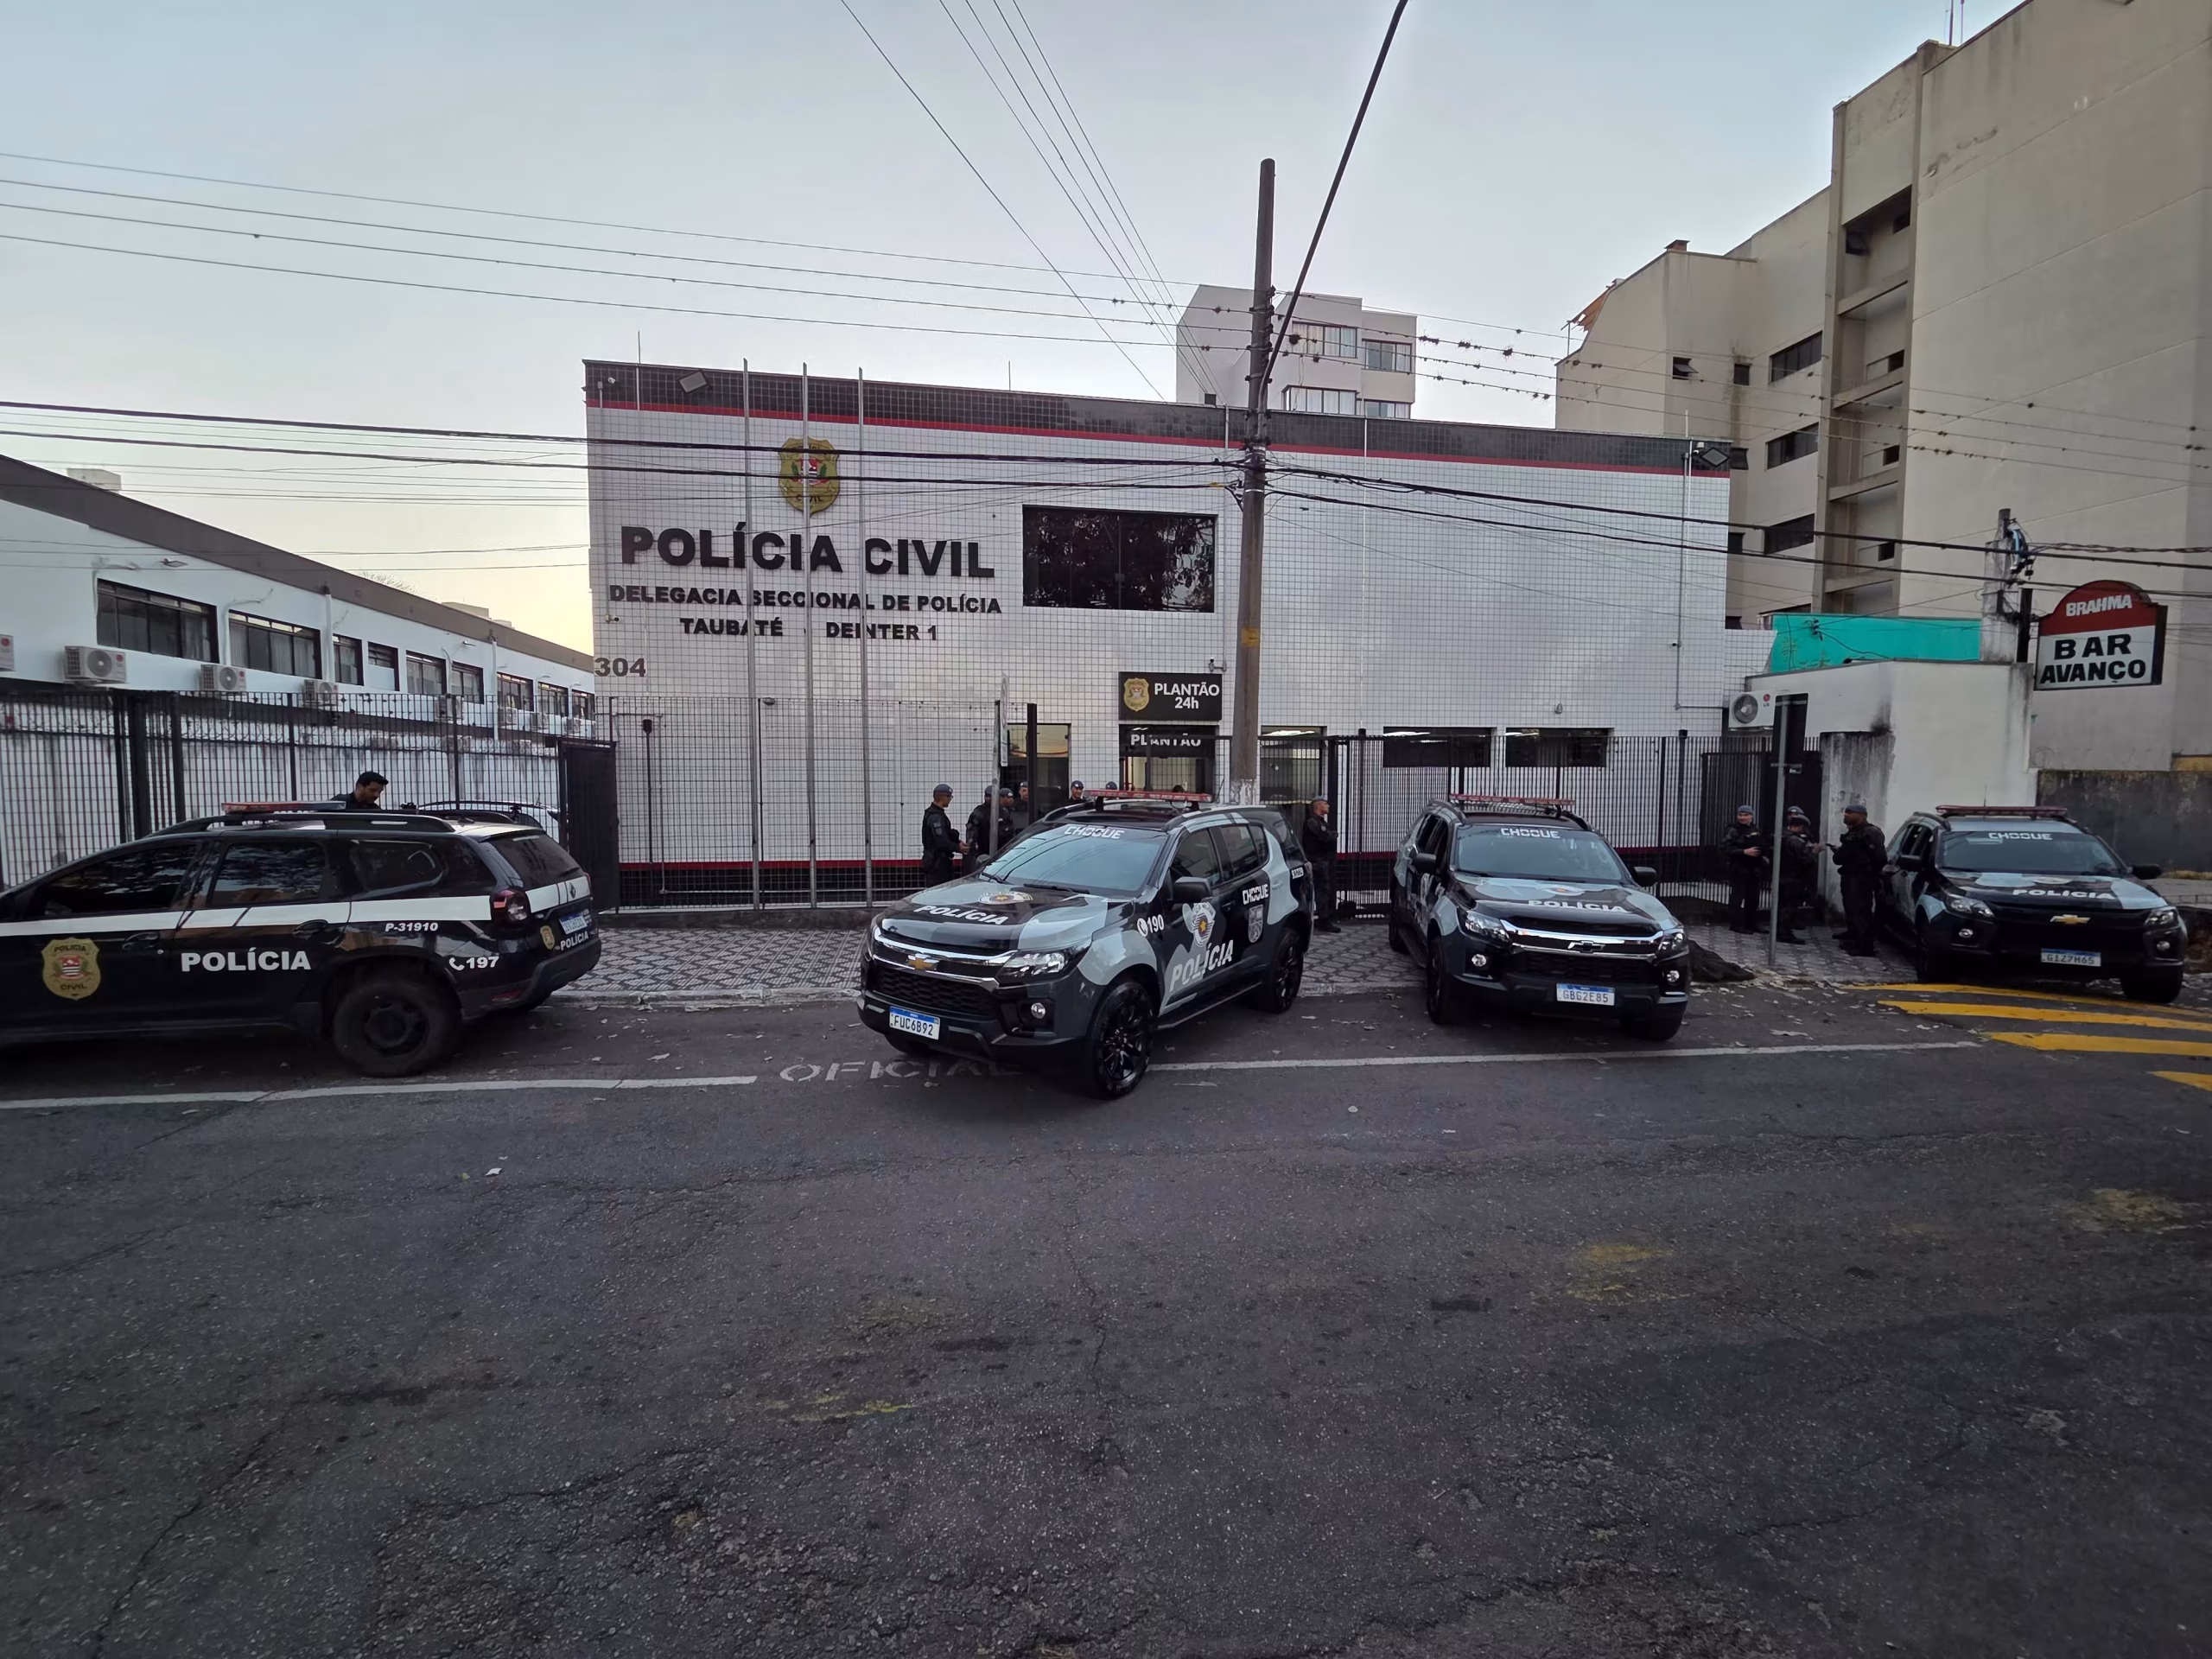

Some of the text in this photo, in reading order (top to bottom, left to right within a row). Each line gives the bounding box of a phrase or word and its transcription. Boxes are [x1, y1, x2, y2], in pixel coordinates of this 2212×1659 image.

[621, 521, 995, 578] POLÍCIA CIVIL
[609, 584, 1002, 614] DELEGACIA SECCIONAL DE POLÍCIA
[2065, 594, 2133, 617] BRAHMA
[679, 616, 937, 641] TAUBATÉ DEINTER 1
[2054, 633, 2132, 660] BAR
[594, 657, 646, 677] 304
[2039, 659, 2146, 683] AVANÇO
[1154, 681, 1220, 697] PLANTÃO
[1174, 696, 1199, 709] 24h
[913, 905, 1009, 925] POLÍCIA
[1147, 914, 1165, 934] 190
[385, 922, 439, 932] P-31910
[560, 930, 589, 951] POLÍCIA
[181, 947, 312, 972] POLÍCIA
[466, 956, 499, 969] 197
[1169, 939, 1234, 993] POLÍCIA
[893, 1014, 934, 1037] FUC6B92
